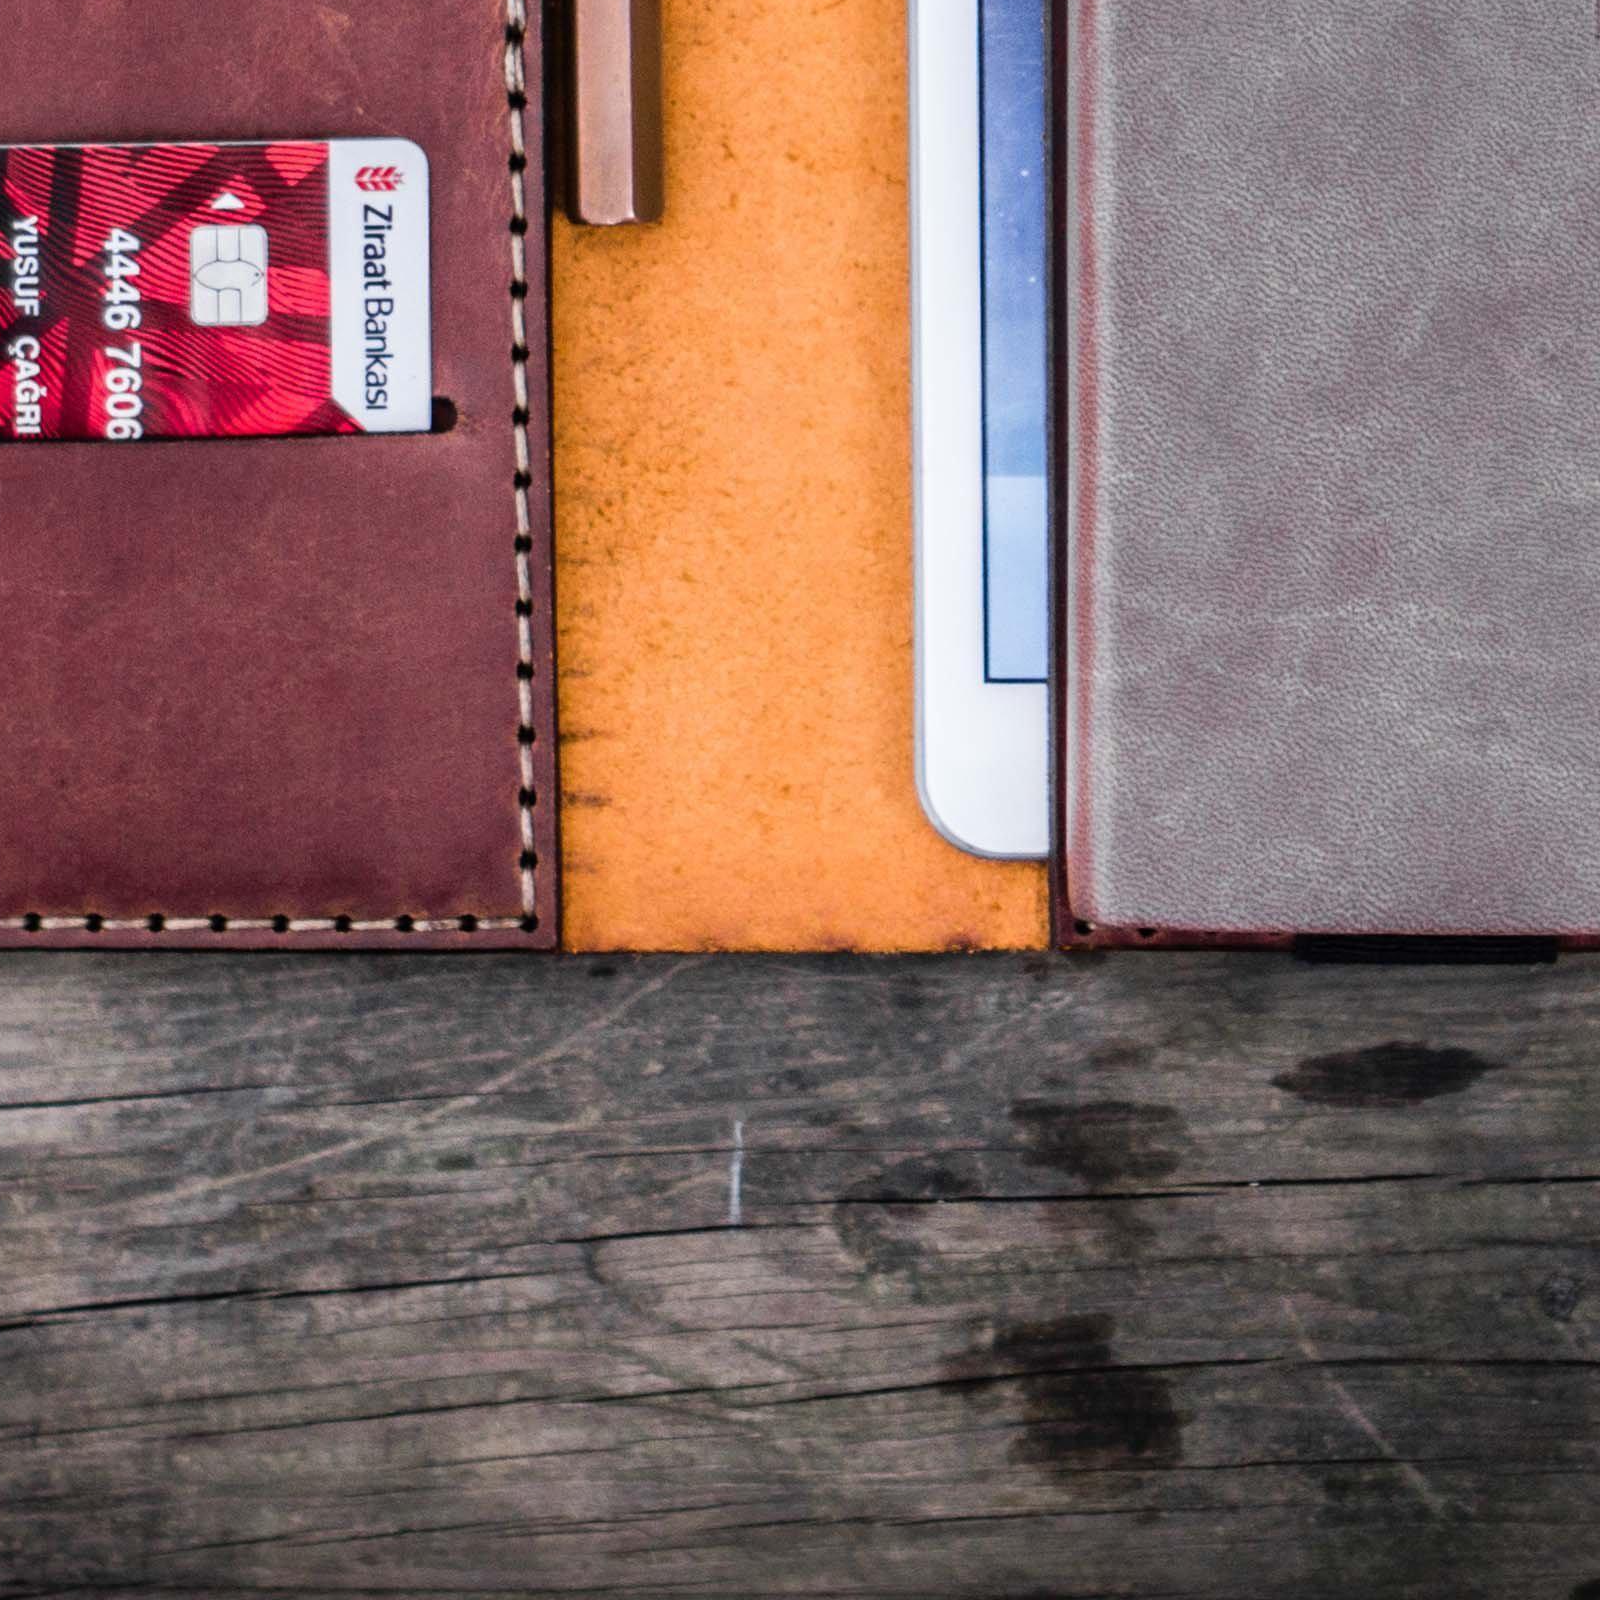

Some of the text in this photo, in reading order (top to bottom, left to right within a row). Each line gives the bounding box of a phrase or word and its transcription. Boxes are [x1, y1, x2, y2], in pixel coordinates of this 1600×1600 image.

[7, 215, 48, 434] YUSUF ÇAĞRI
[104, 227, 144, 440] 4446 7606
[363, 204, 393, 290] Ziraat
